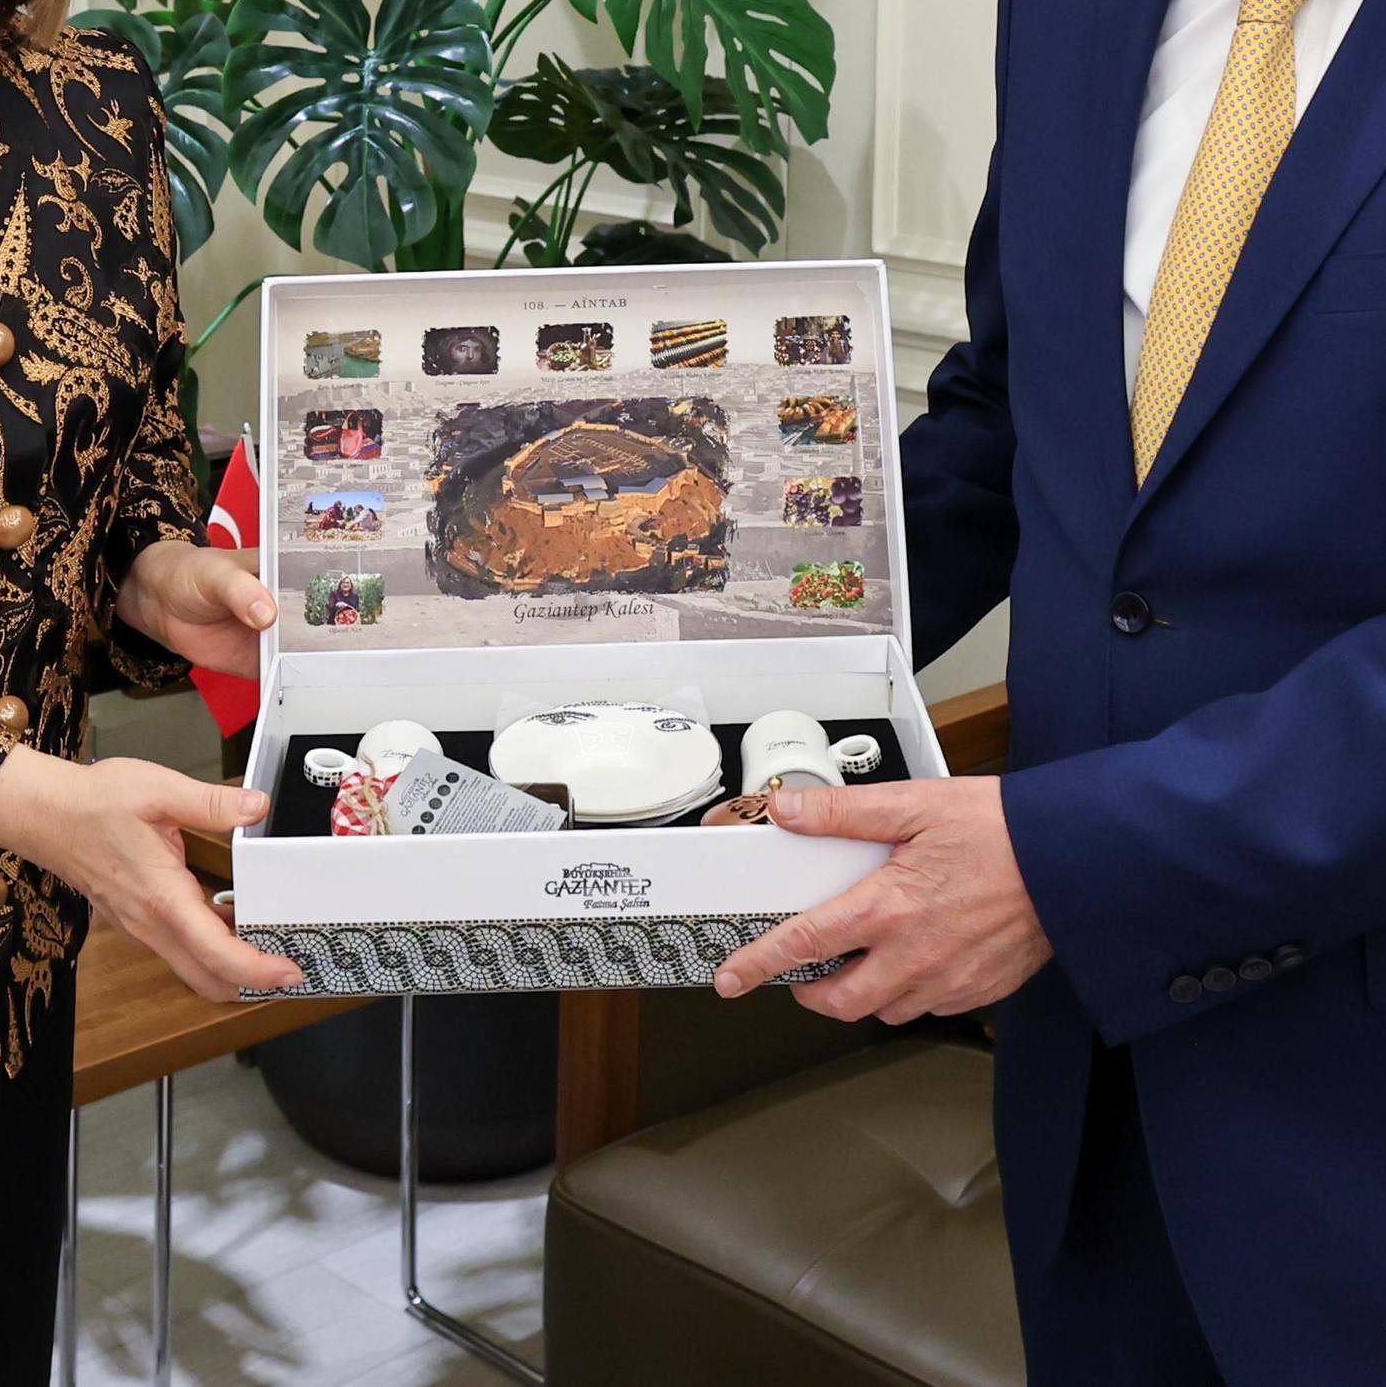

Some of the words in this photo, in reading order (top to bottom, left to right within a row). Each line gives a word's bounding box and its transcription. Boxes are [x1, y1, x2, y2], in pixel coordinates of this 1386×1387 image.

[513, 602, 598, 624] Gaziantep
[583, 899, 618, 910] Fatma
[619, 896, 650, 912] Şahin
